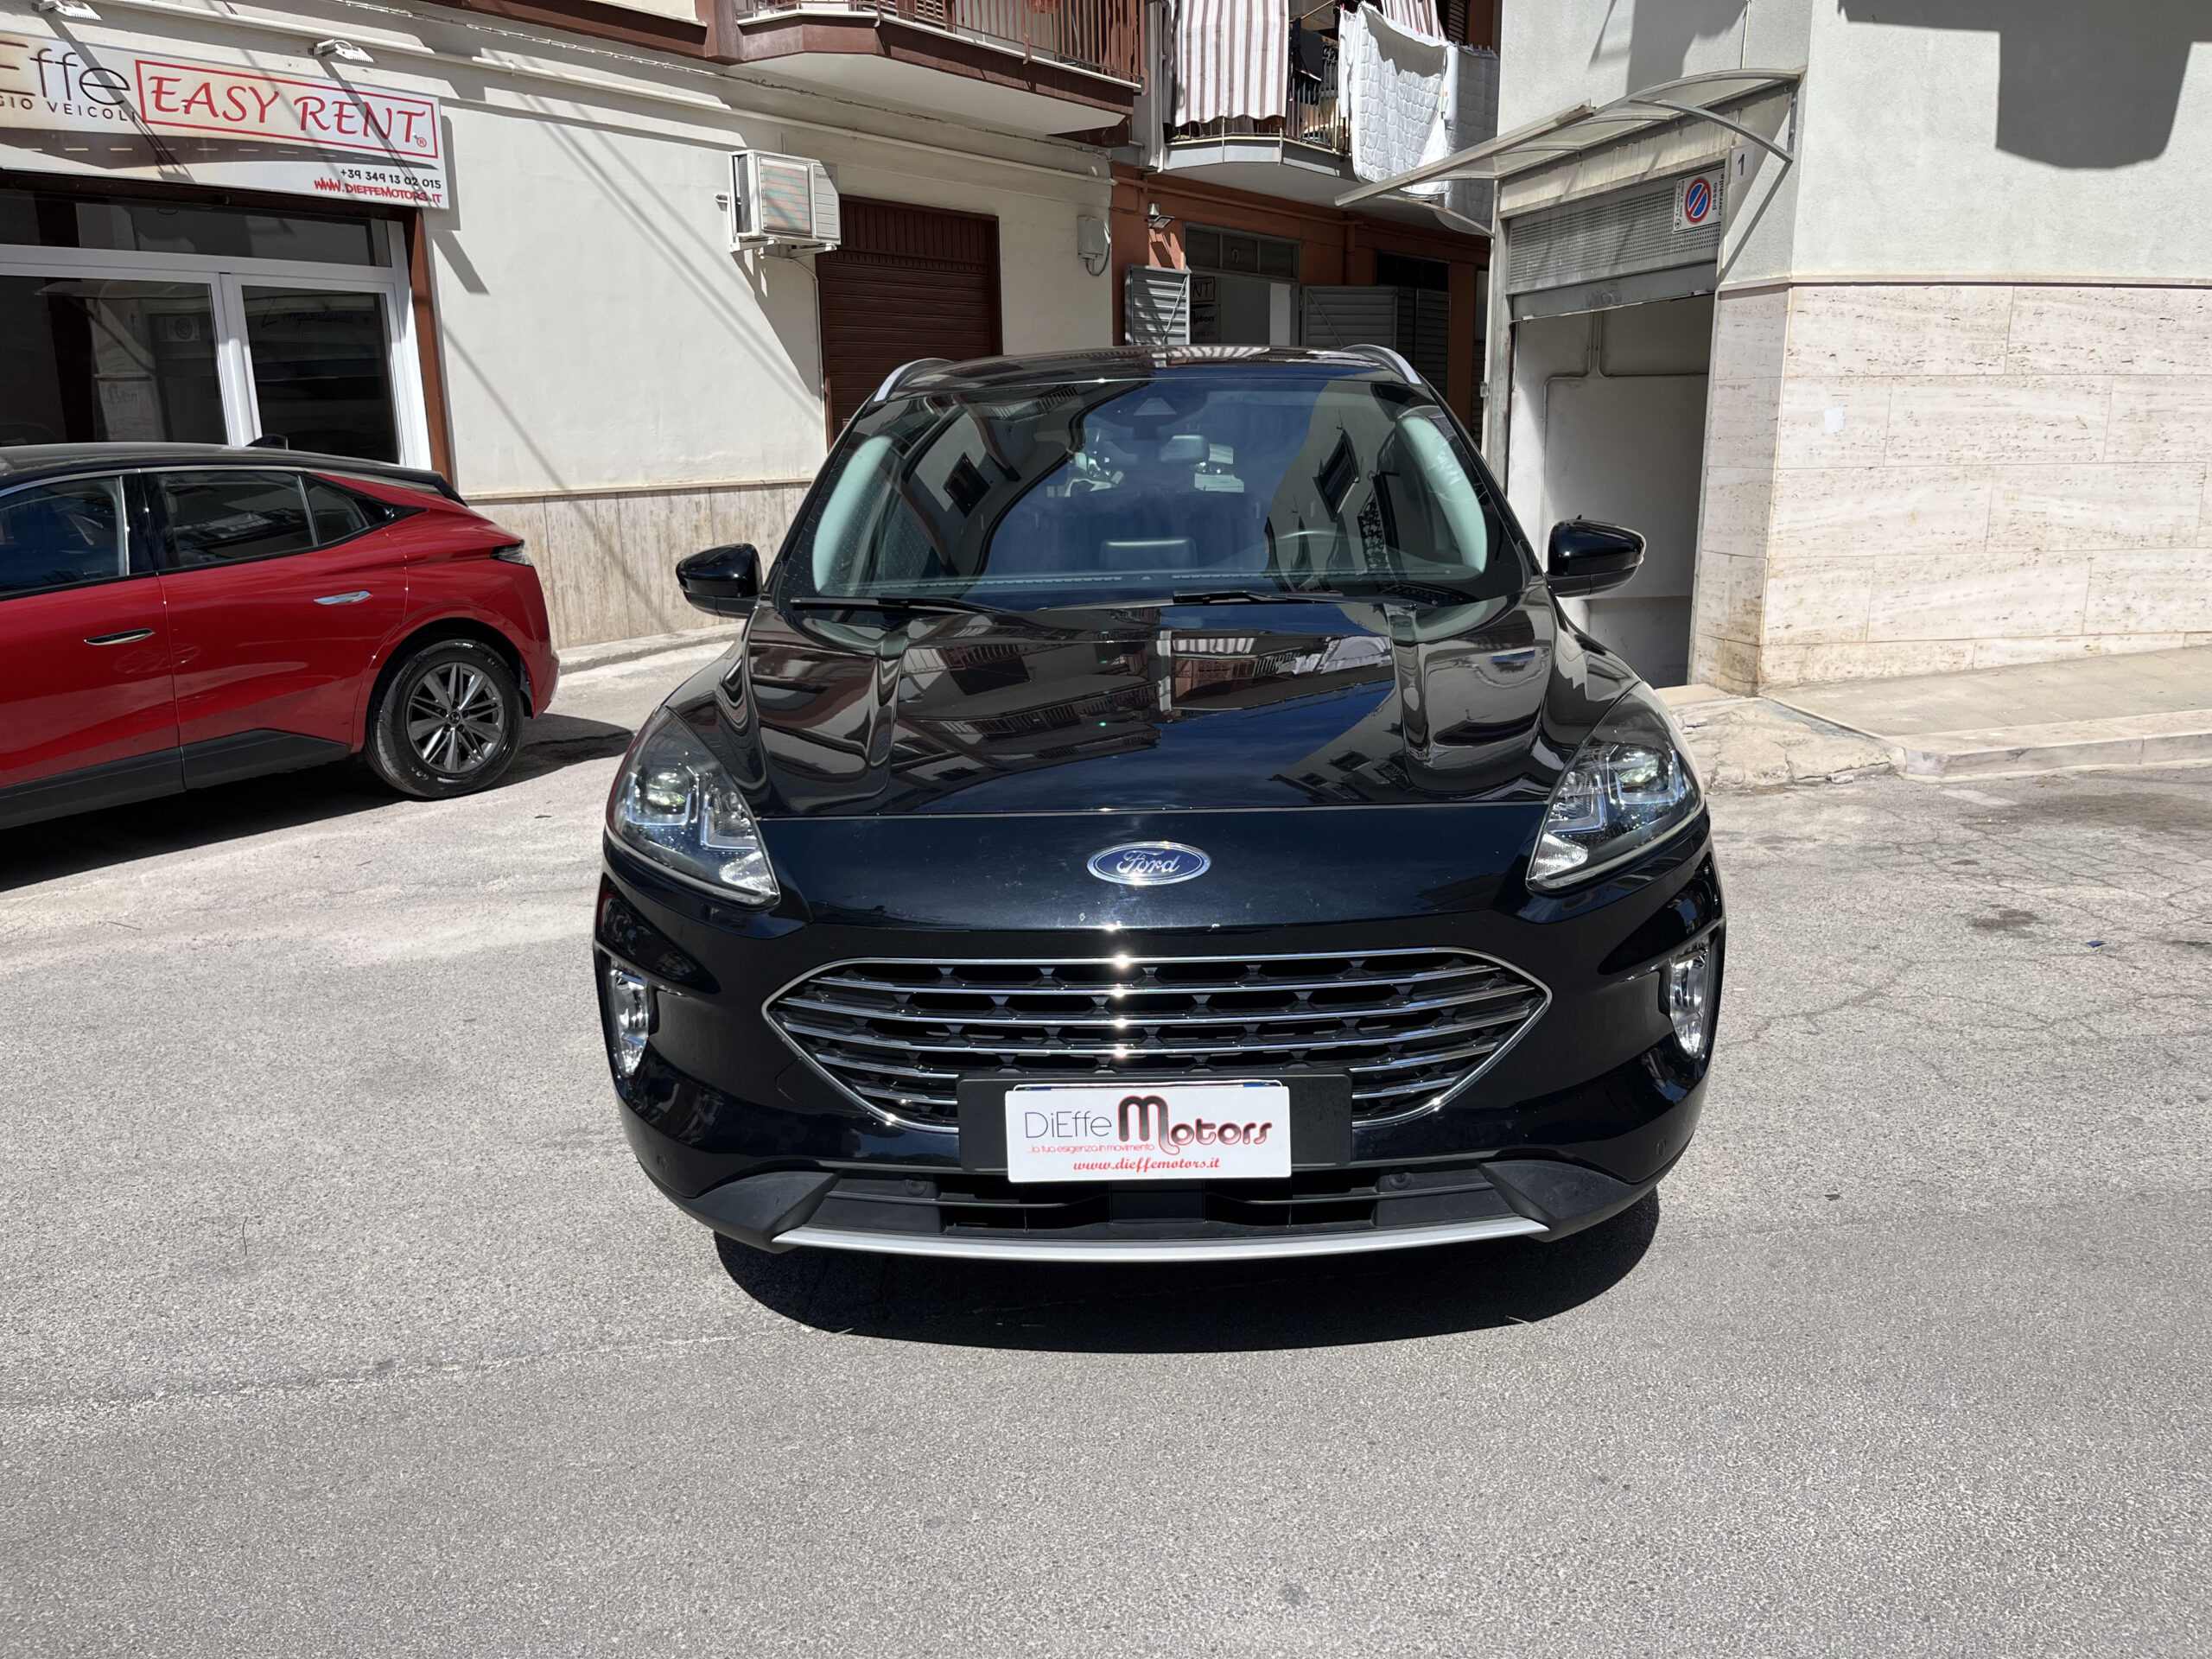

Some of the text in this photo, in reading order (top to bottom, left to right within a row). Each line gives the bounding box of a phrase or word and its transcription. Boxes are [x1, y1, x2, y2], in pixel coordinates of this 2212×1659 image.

[148, 76, 279, 124] EASY
[47, 101, 137, 124] VEICOLI
[1738, 154, 1745, 175] 1
[340, 169, 442, 189] +39 349 13 02 015
[1191, 281, 1212, 298] NT
[1116, 849, 1181, 874] Ford
[1025, 1095, 1273, 1155] DiEffe Motors
[1041, 1145, 1056, 1154] tua
[1057, 1145, 1097, 1154] esigenza
[1107, 1142, 1155, 1152] movimento
[1073, 1157, 1220, 1173] www.dieffemotors.it
